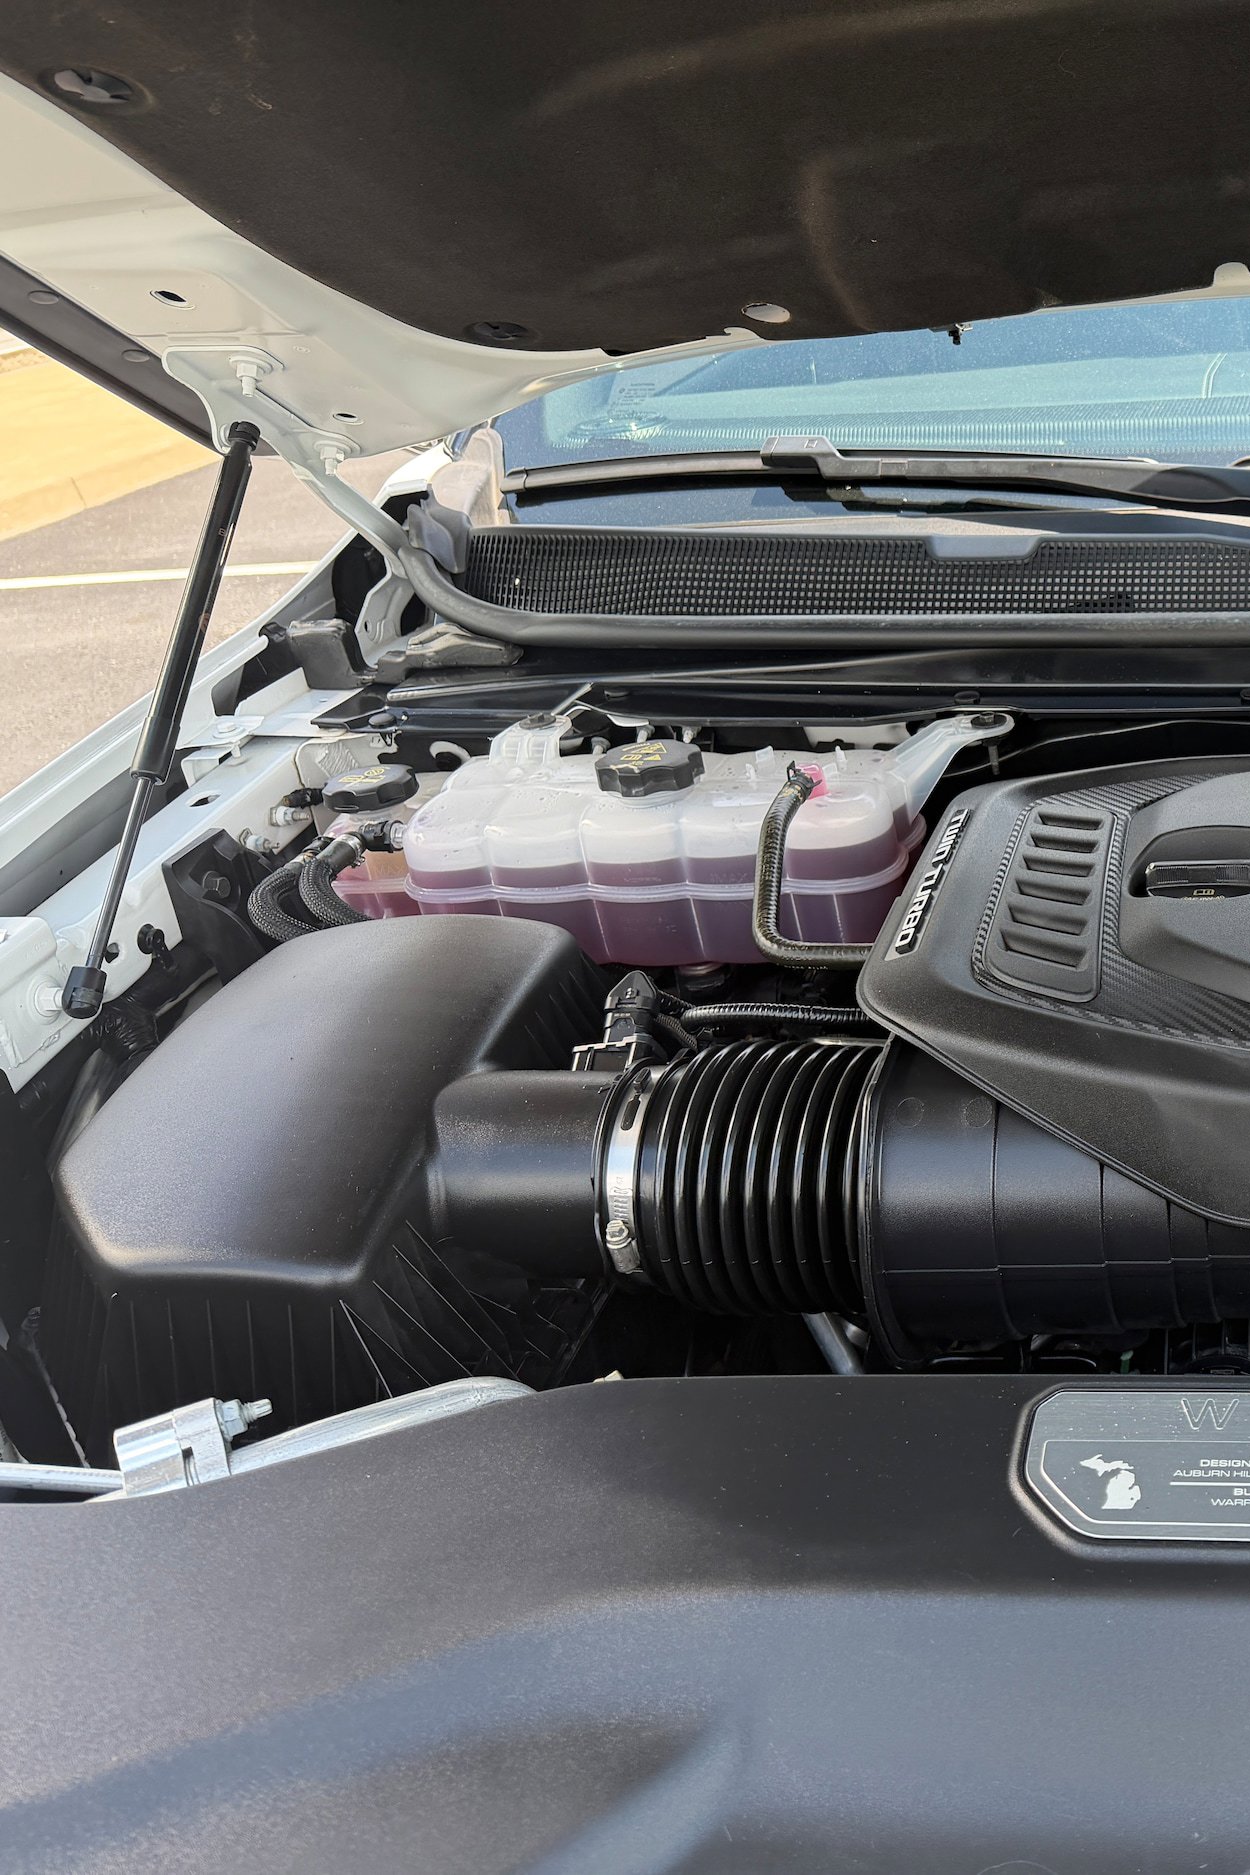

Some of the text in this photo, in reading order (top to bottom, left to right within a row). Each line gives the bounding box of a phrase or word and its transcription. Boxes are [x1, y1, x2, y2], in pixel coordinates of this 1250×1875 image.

[895, 808, 970, 952] TWIN TURBO
[1173, 1469, 1231, 1479] AUBURN
